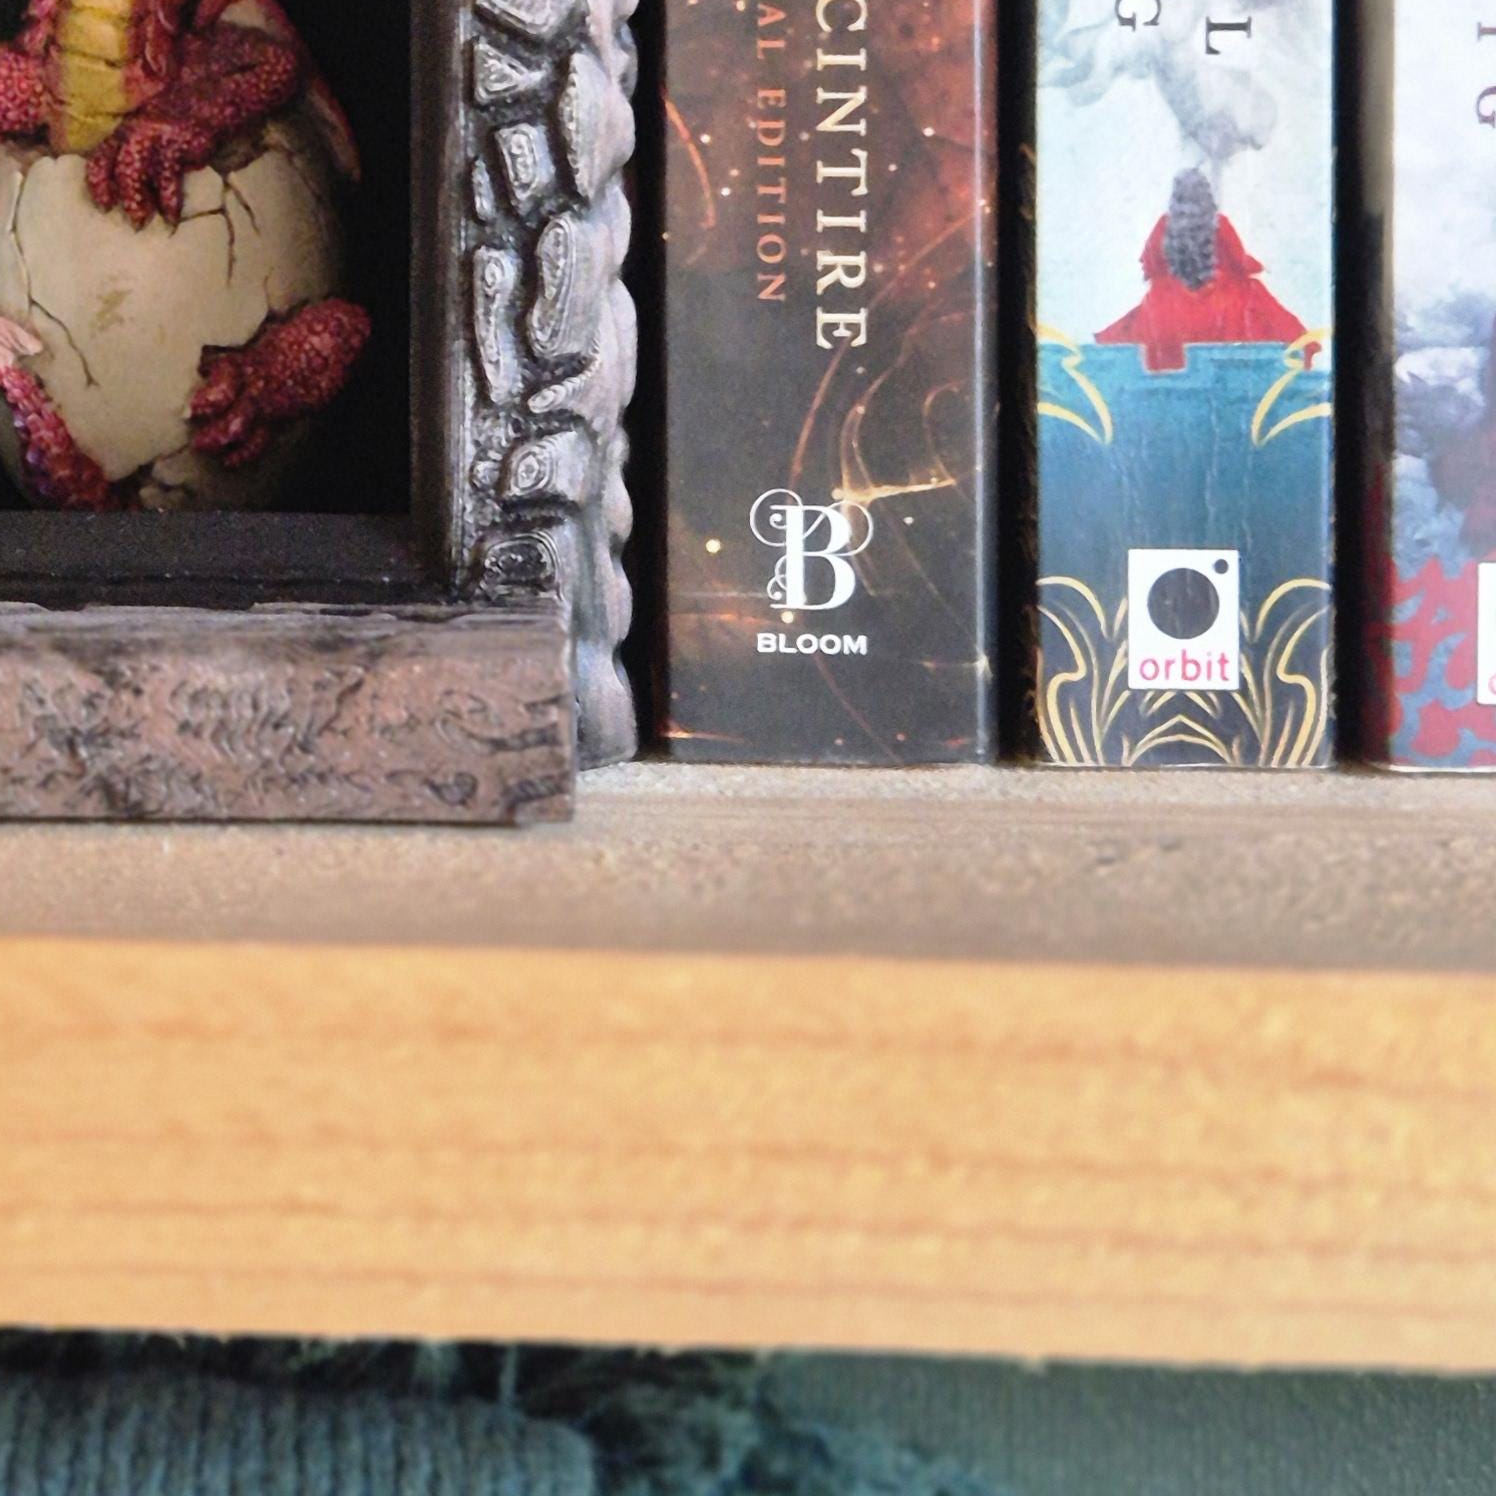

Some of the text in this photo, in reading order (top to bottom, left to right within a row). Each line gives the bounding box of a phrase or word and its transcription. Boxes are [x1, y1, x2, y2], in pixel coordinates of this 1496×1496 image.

[754, 87, 788, 305] EDITION
[756, 632, 868, 655] BLOOM
[1138, 649, 1230, 681] orbit
